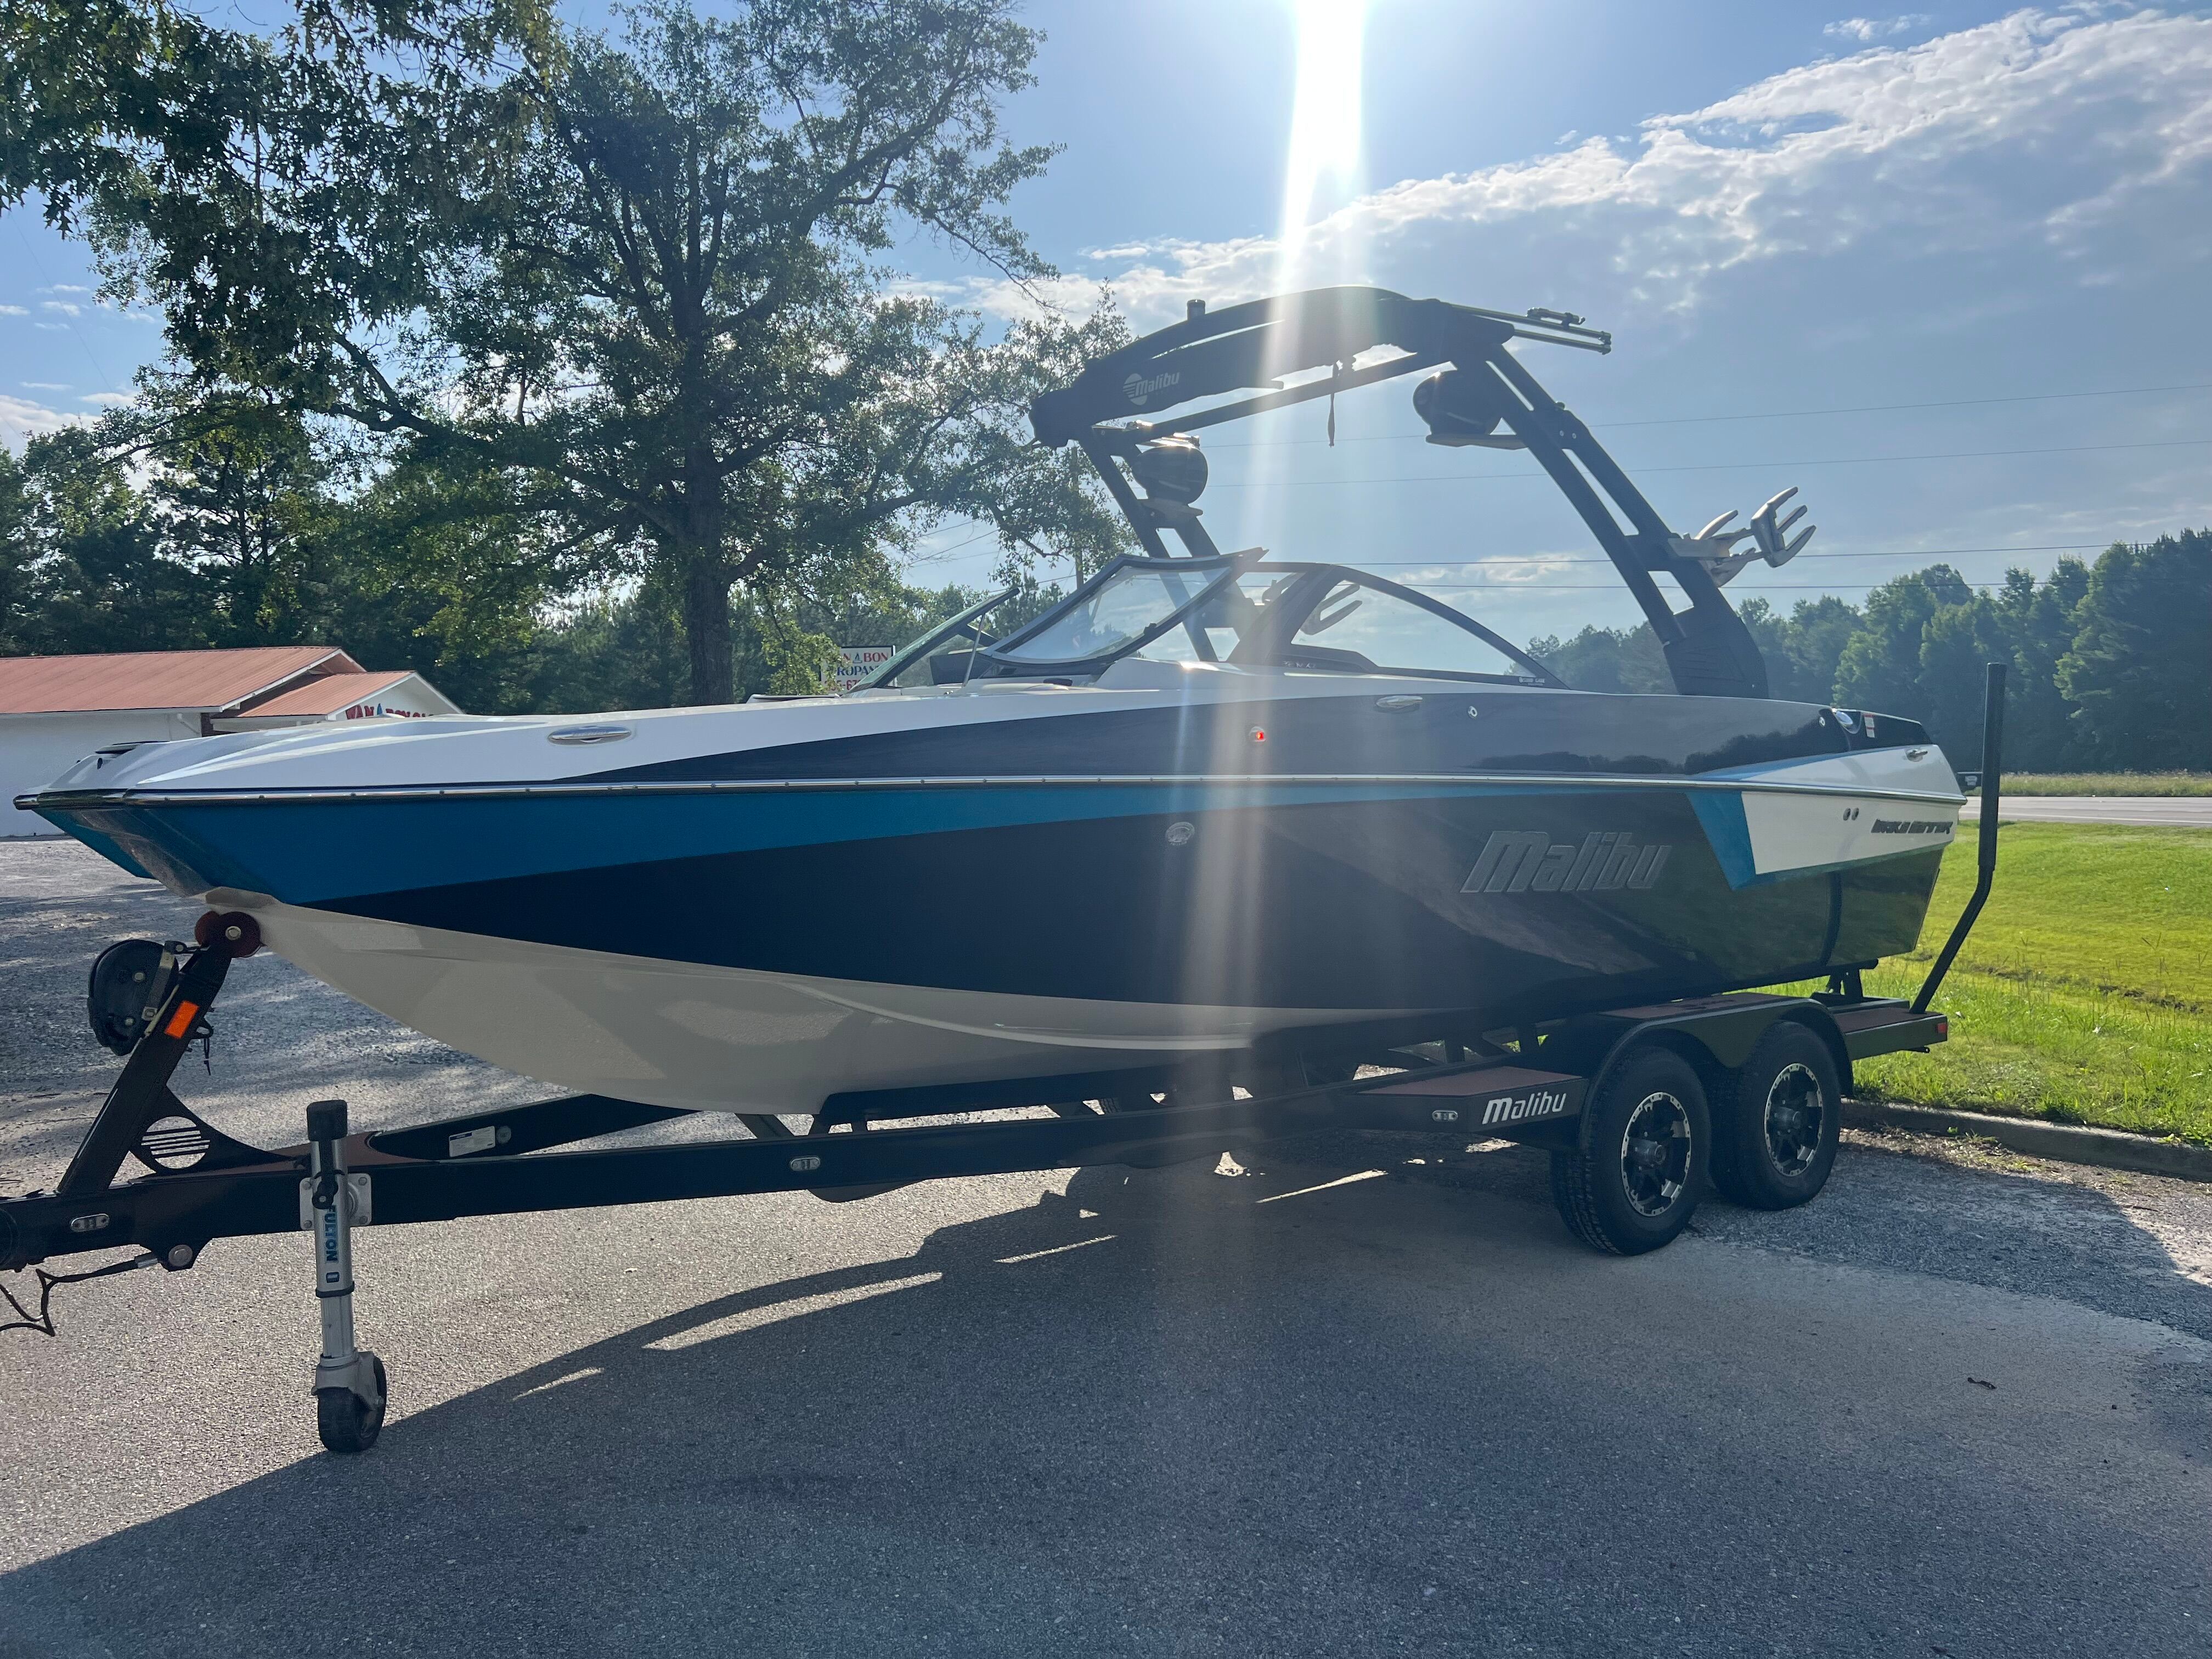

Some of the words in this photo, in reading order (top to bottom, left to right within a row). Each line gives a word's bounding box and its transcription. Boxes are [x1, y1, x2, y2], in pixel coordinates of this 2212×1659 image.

[1135, 372, 1180, 397] Malibu
[864, 652, 888, 663] BON
[828, 665, 879, 676] ROPAN
[1459, 830, 1672, 893] Malibu
[1482, 1091, 1567, 1125] Malibu
